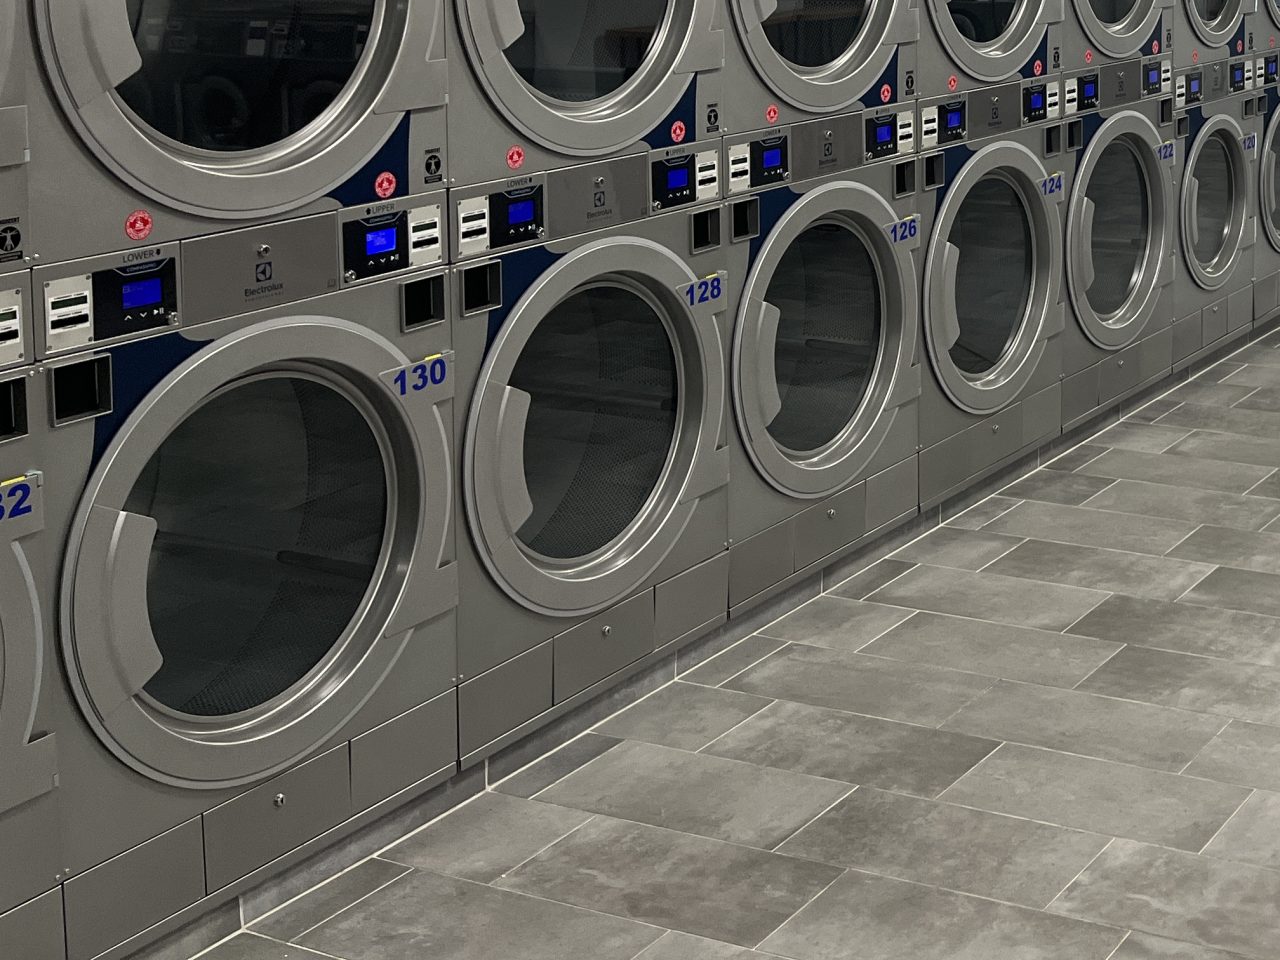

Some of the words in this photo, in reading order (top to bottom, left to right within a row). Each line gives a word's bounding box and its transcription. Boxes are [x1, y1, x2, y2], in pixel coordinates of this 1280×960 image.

[1242, 135, 1256, 151] 120
[1157, 143, 1174, 160] 122
[506, 177, 528, 188] LOWER
[1041, 175, 1063, 196] 124
[371, 203, 395, 215] UPPER
[890, 219, 917, 243] 126
[122, 249, 155, 264] LOWER
[244, 282, 284, 297] Electrolux
[685, 277, 722, 306] 128
[393, 358, 447, 396] 130
